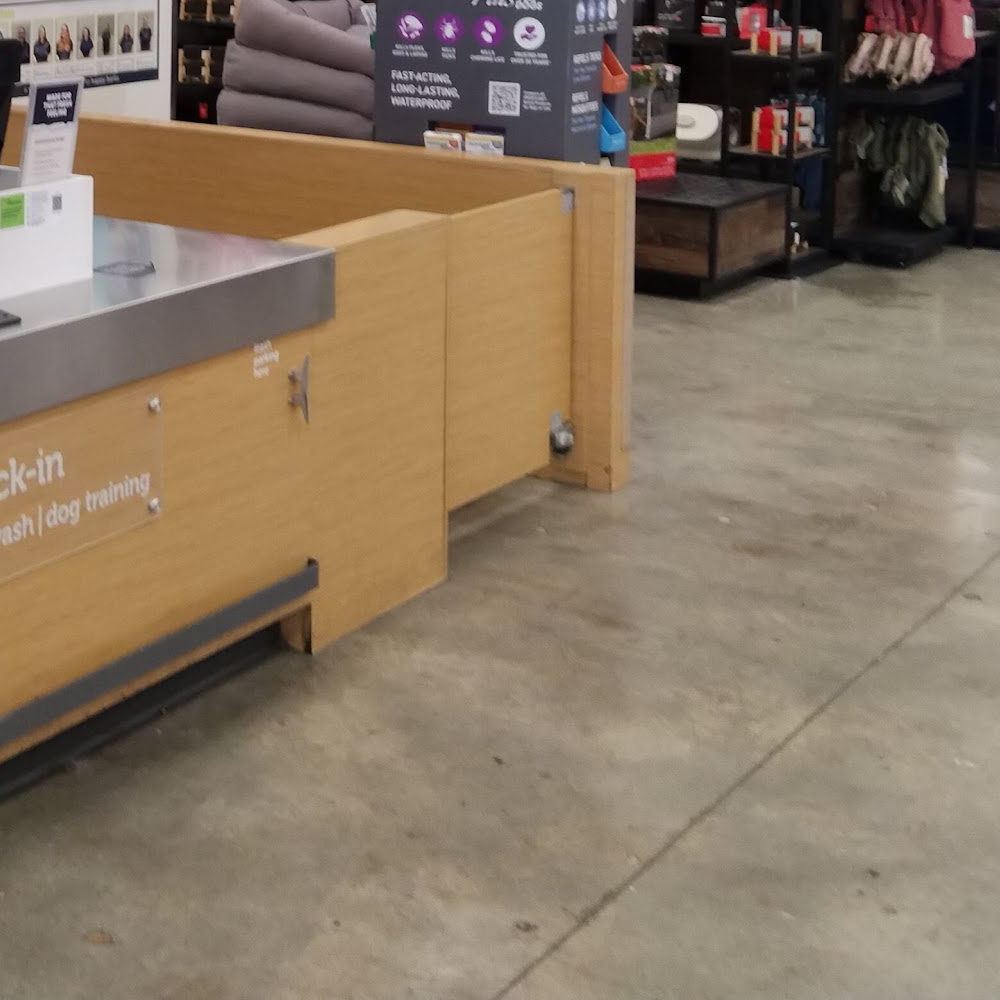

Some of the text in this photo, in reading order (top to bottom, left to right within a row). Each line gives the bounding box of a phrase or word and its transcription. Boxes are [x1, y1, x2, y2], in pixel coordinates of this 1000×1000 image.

[391, 96, 452, 110] WATERPROOF
[45, 498, 81, 528] dog
[85, 471, 151, 513] training
